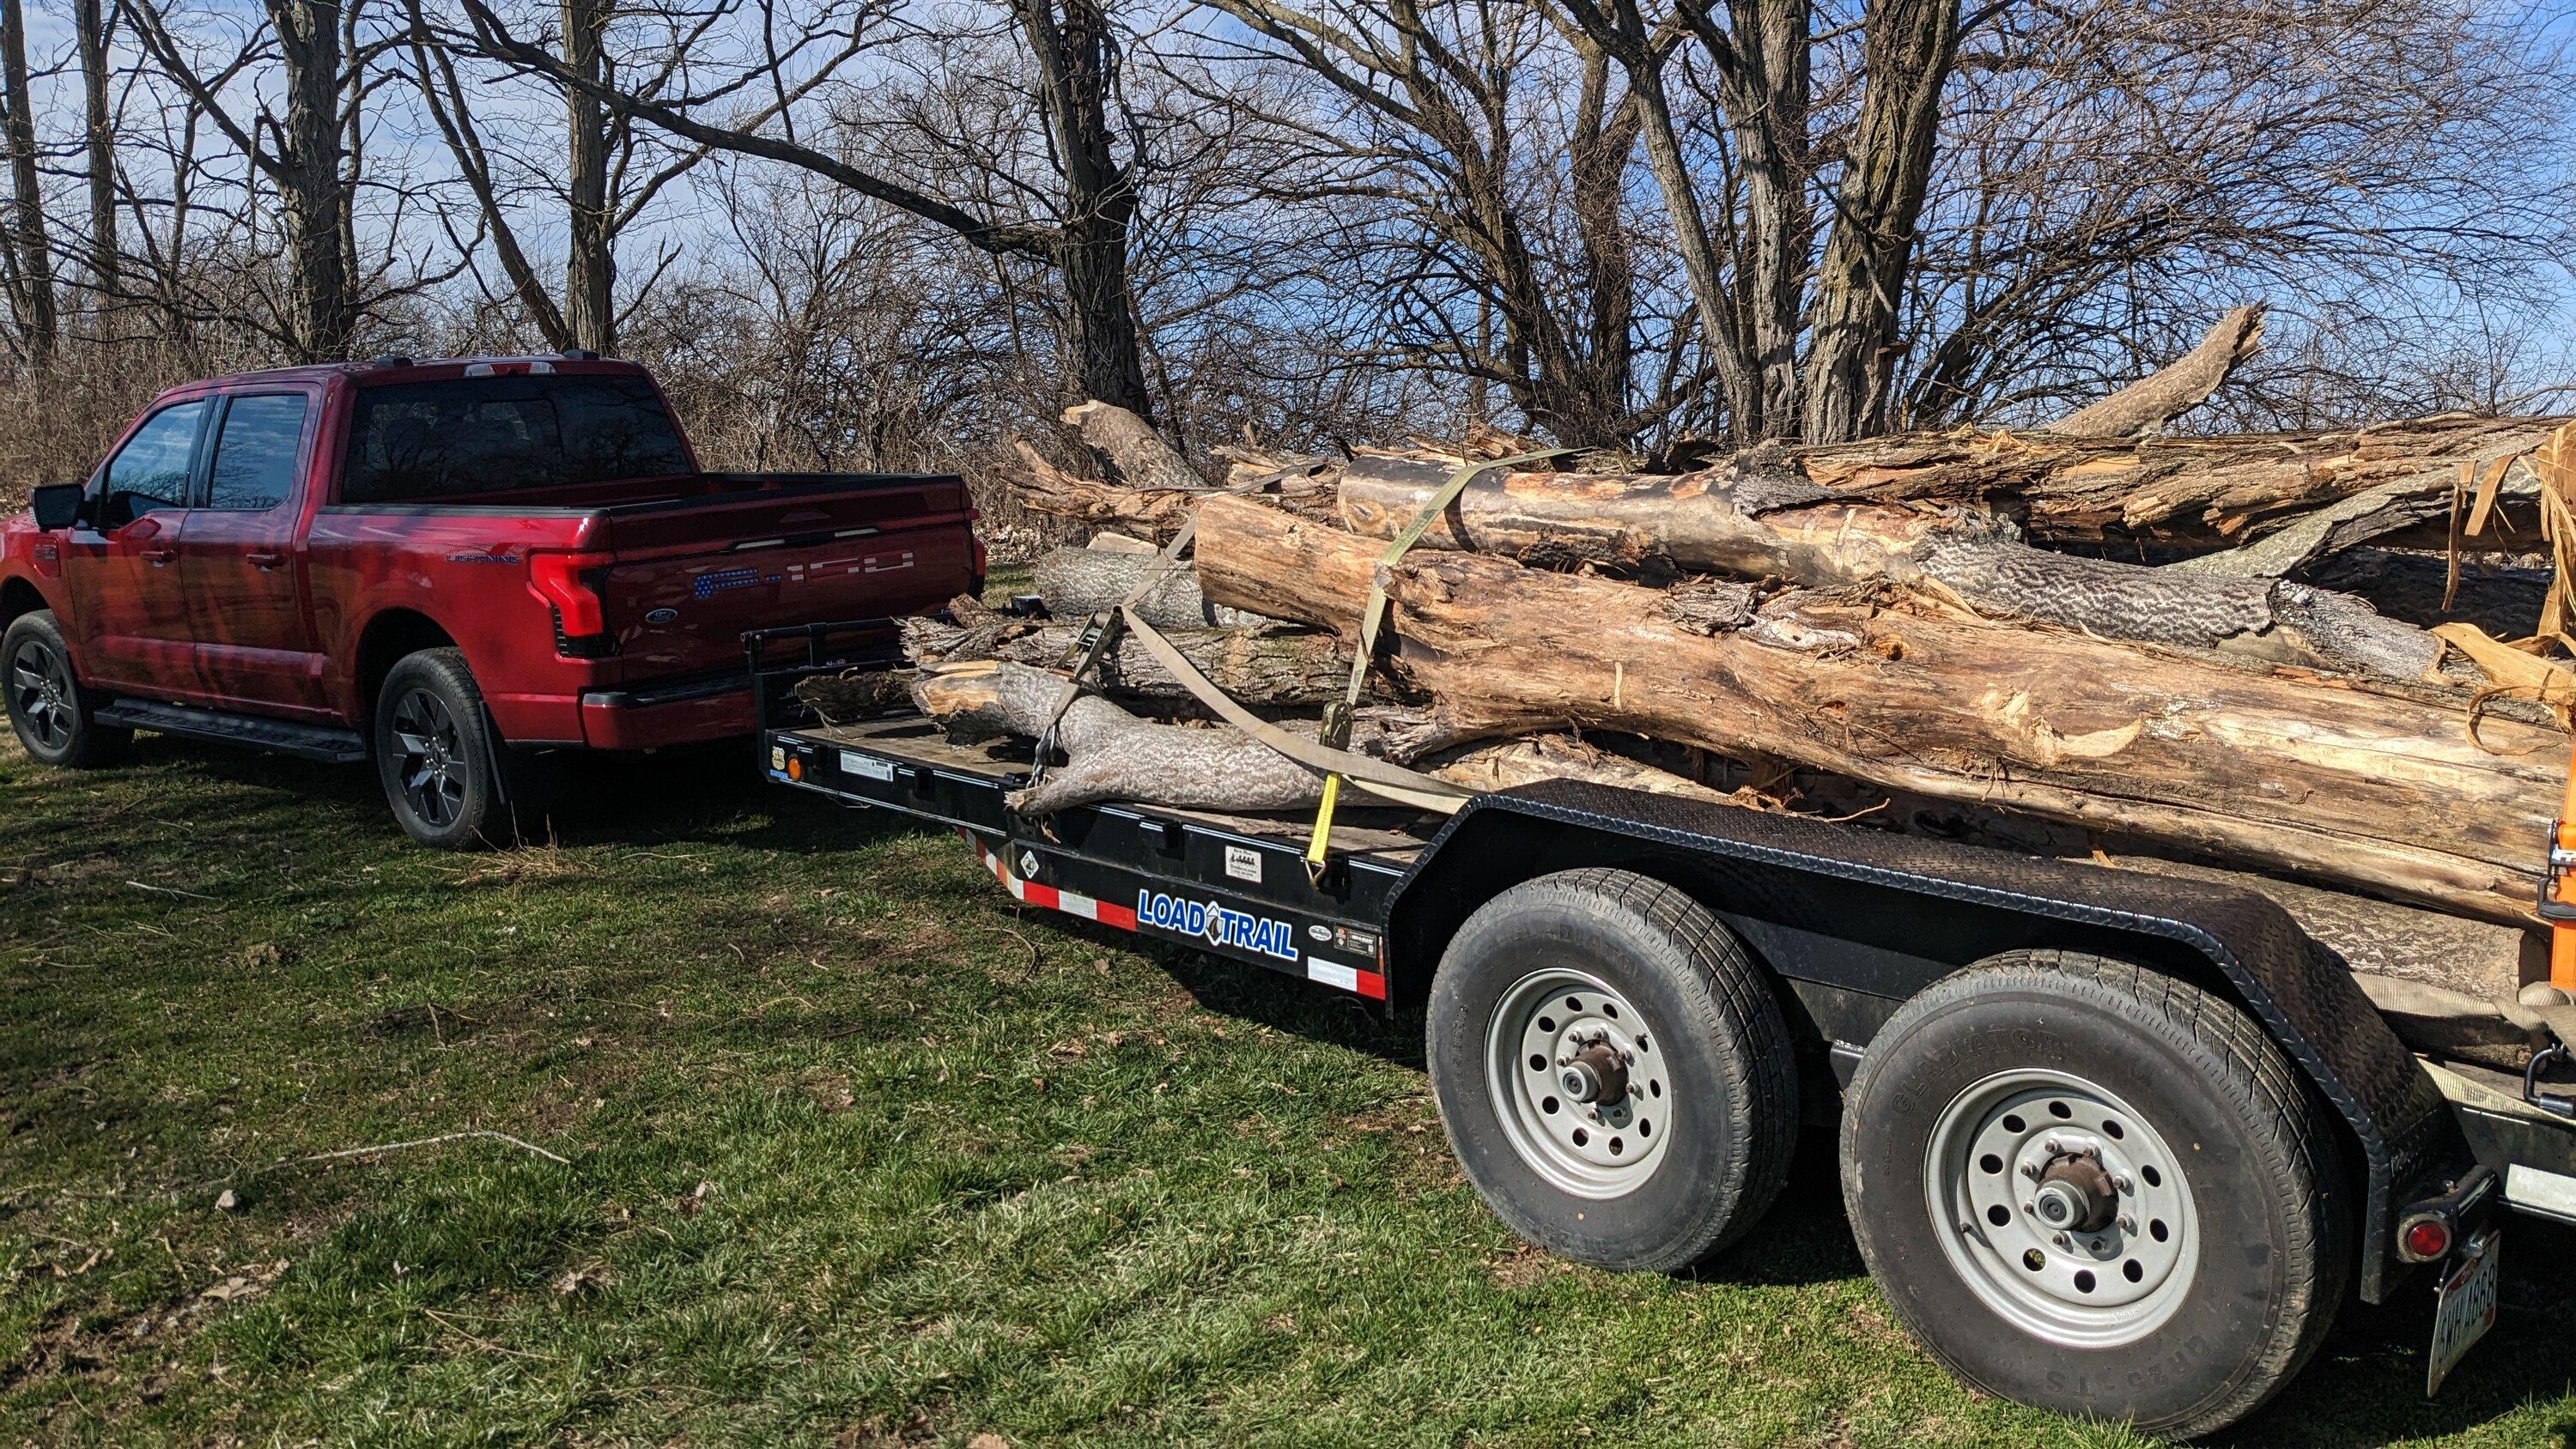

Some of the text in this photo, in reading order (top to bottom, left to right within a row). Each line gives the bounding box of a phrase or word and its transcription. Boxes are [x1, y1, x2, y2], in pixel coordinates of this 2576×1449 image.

[447, 554, 519, 564] LIGHTNING
[695, 550, 914, 598] F-150
[1139, 890, 1206, 936] LOAD
[1218, 908, 1298, 960] TRAIL
